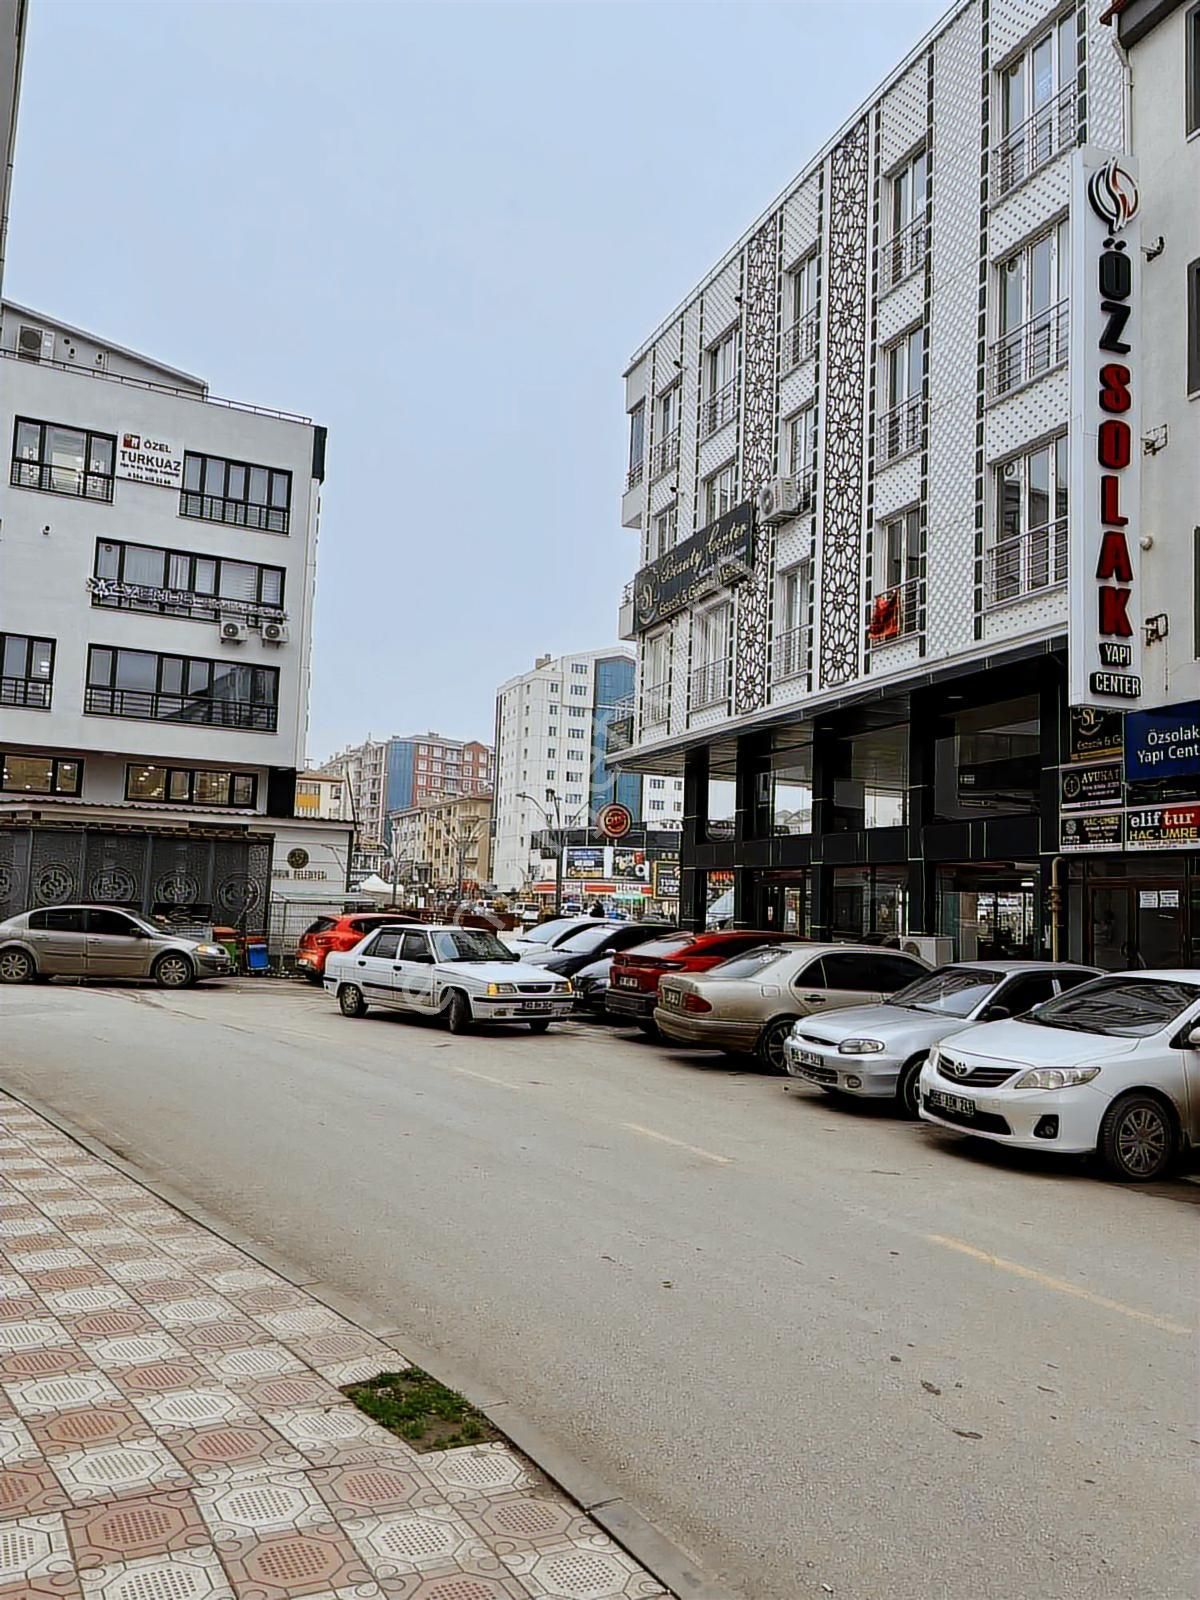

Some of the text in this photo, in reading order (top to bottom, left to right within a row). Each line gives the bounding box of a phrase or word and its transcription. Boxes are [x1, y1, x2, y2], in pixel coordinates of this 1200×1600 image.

[1104, 644, 1131, 665] YAPI
[1095, 673, 1140, 697] CENTER
[1147, 724, 1200, 746] Özsolak
[1138, 749, 1164, 765] Yapı
[1130, 811, 1195, 828] elif tur
